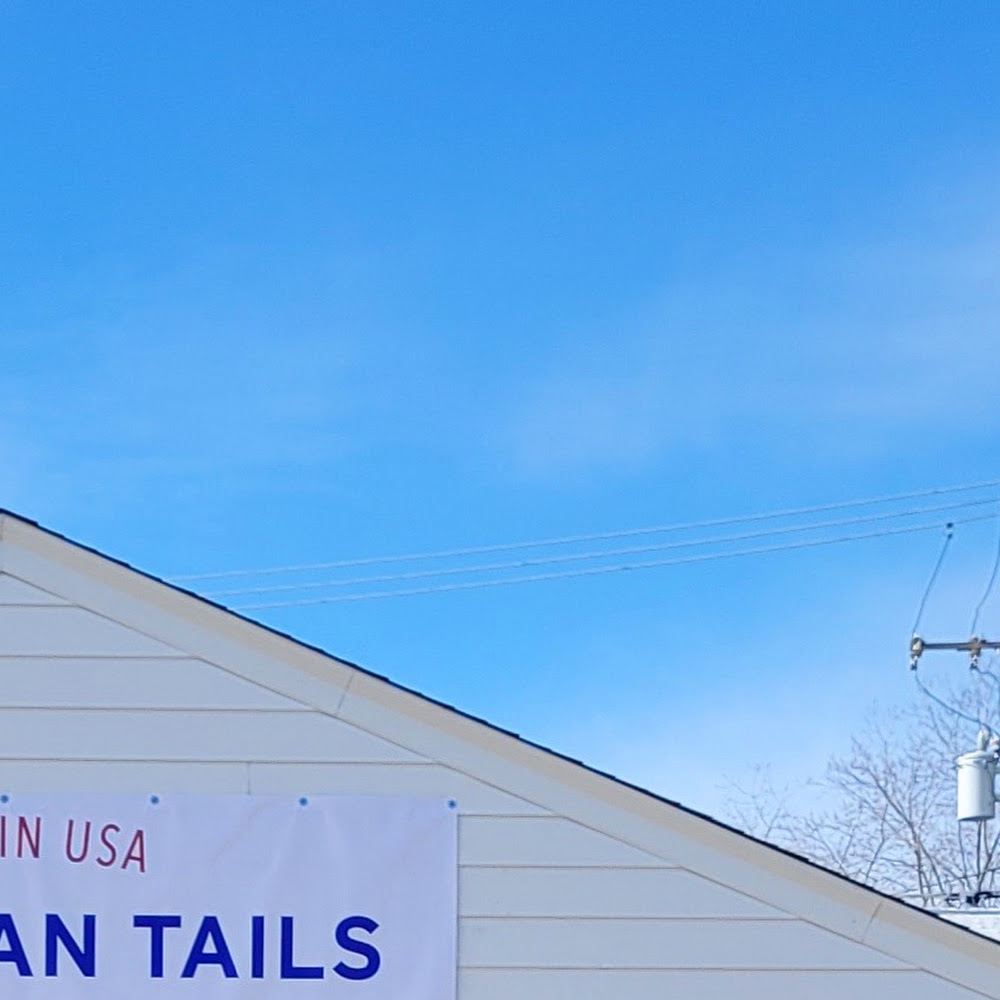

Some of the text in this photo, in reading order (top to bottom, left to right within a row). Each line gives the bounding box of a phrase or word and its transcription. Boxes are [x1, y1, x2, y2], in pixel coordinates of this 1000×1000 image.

[0, 815, 41, 859] IN
[65, 819, 146, 873] USA
[132, 914, 381, 981] TAILS
